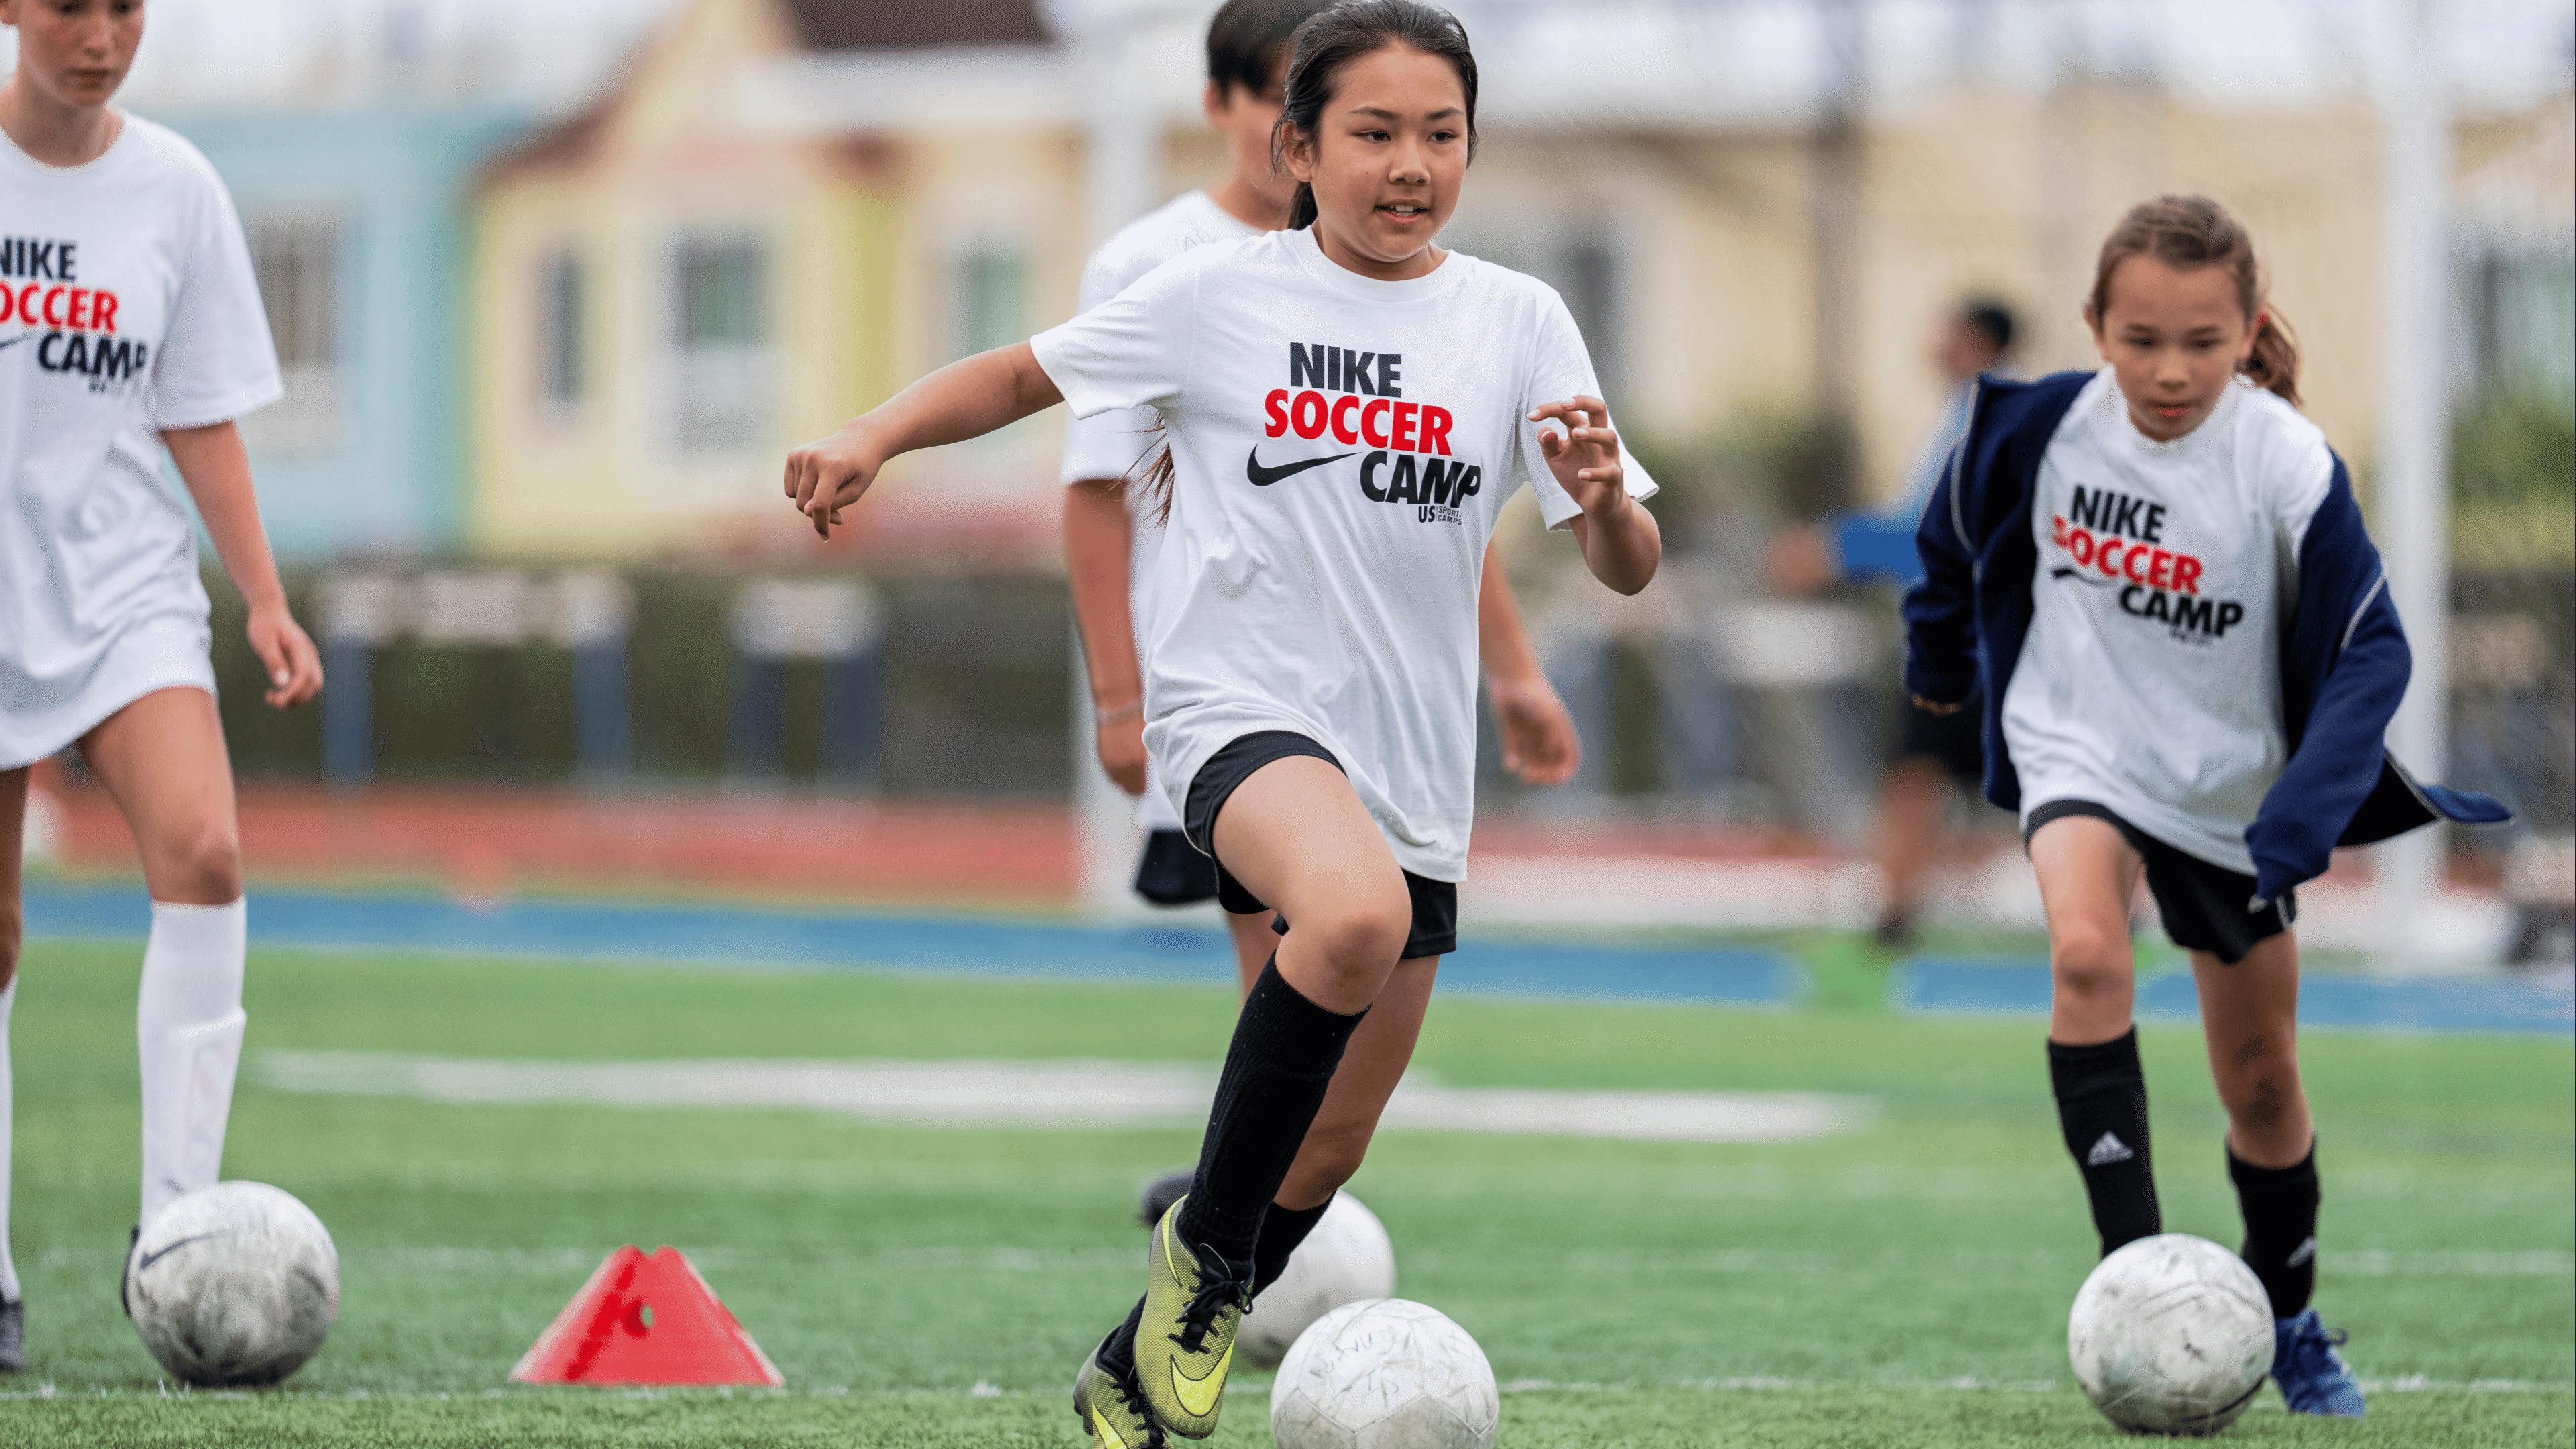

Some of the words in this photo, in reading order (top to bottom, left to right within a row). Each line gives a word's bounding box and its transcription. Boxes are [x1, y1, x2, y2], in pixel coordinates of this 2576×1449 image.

[0, 279, 119, 335] OCCER
[38, 331, 147, 379] CAMP
[1290, 341, 1402, 398] NIKE
[1265, 388, 1453, 456] SOCCER
[1360, 450, 1481, 508] CAMP
[1418, 505, 1436, 523] US
[1438, 514, 1462, 525] CAMPS
[2070, 485, 2167, 544] NIKE
[2118, 585, 2244, 637] CAMP
